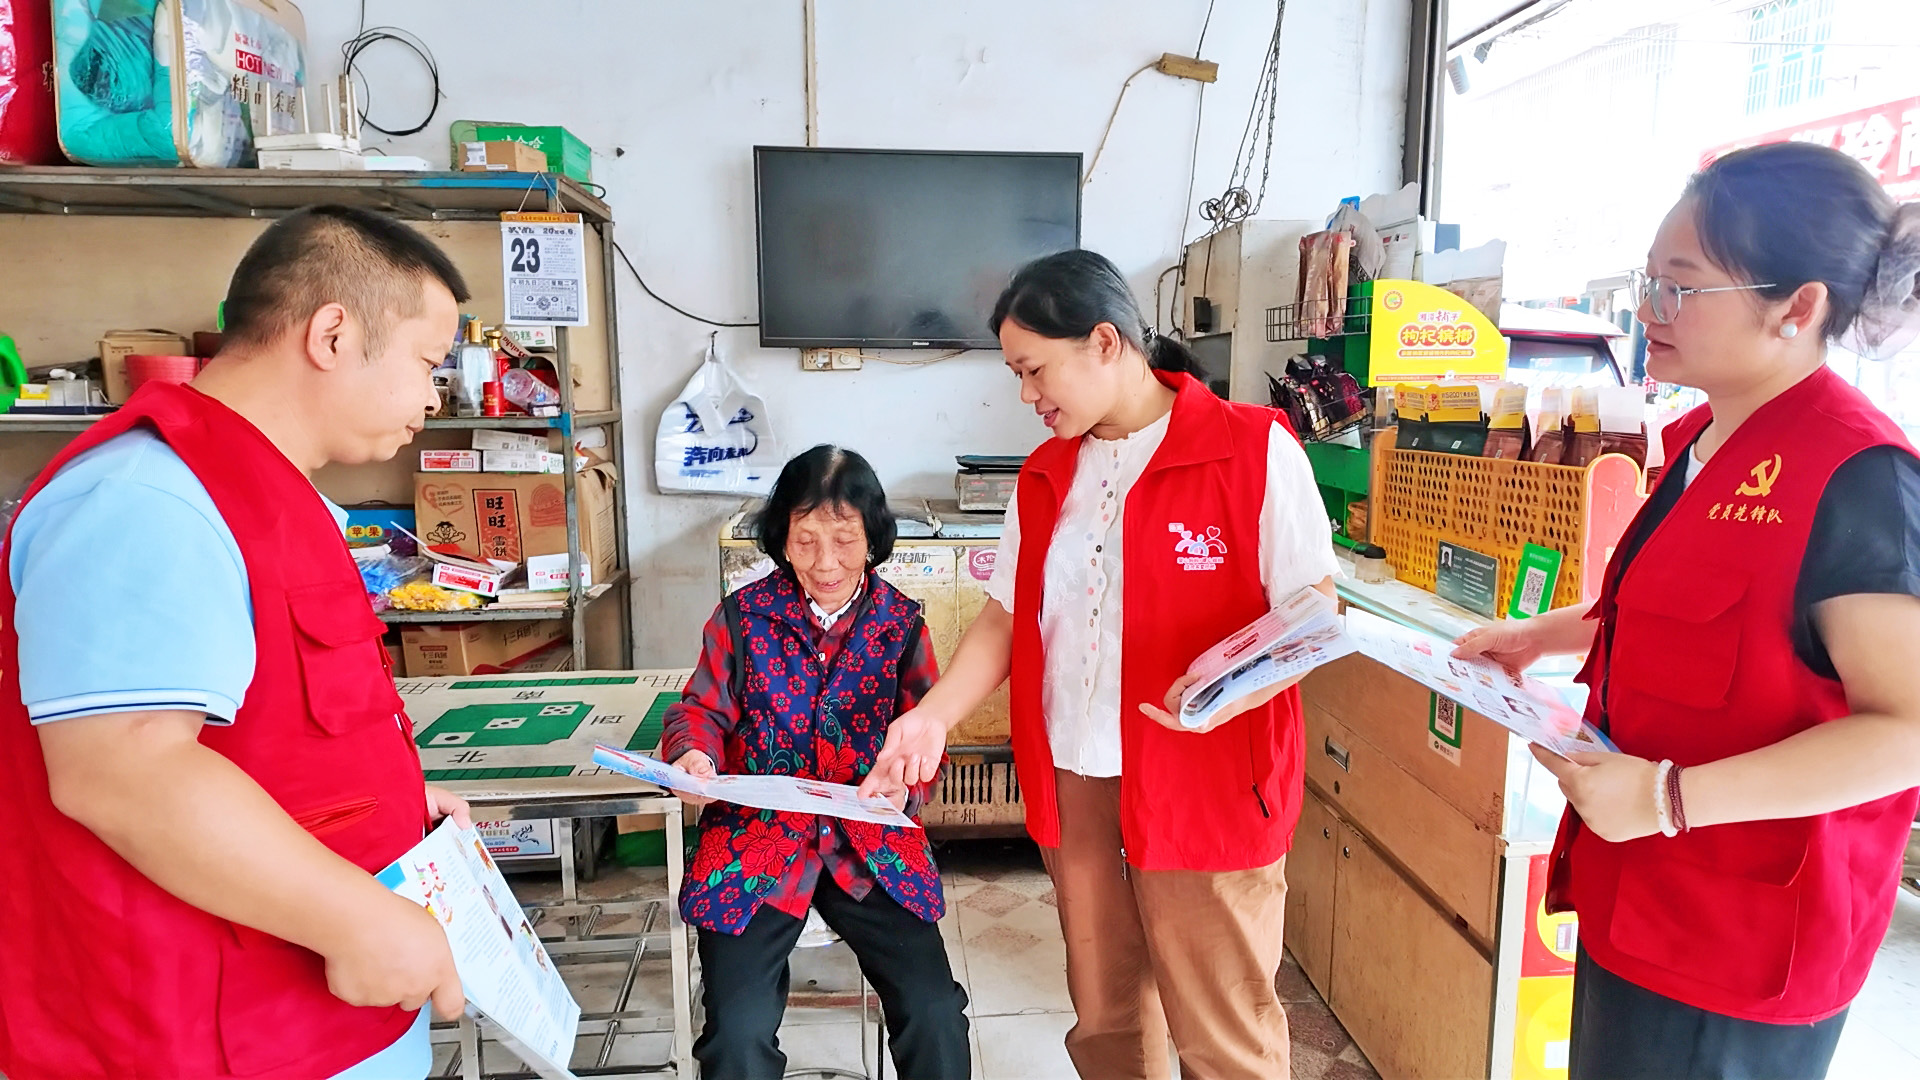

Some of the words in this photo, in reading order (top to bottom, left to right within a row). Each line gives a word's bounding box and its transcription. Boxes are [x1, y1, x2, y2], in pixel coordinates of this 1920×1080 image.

[236, 50, 262, 72] HOT
[510, 237, 541, 273] 23
[1402, 327, 1474, 344] 枸杞槟榔
[1706, 502, 1783, 525] 党员先锋队
[351, 526, 380, 537] 苹果
[446, 750, 488, 763] 北
[941, 808, 976, 824] 广州
